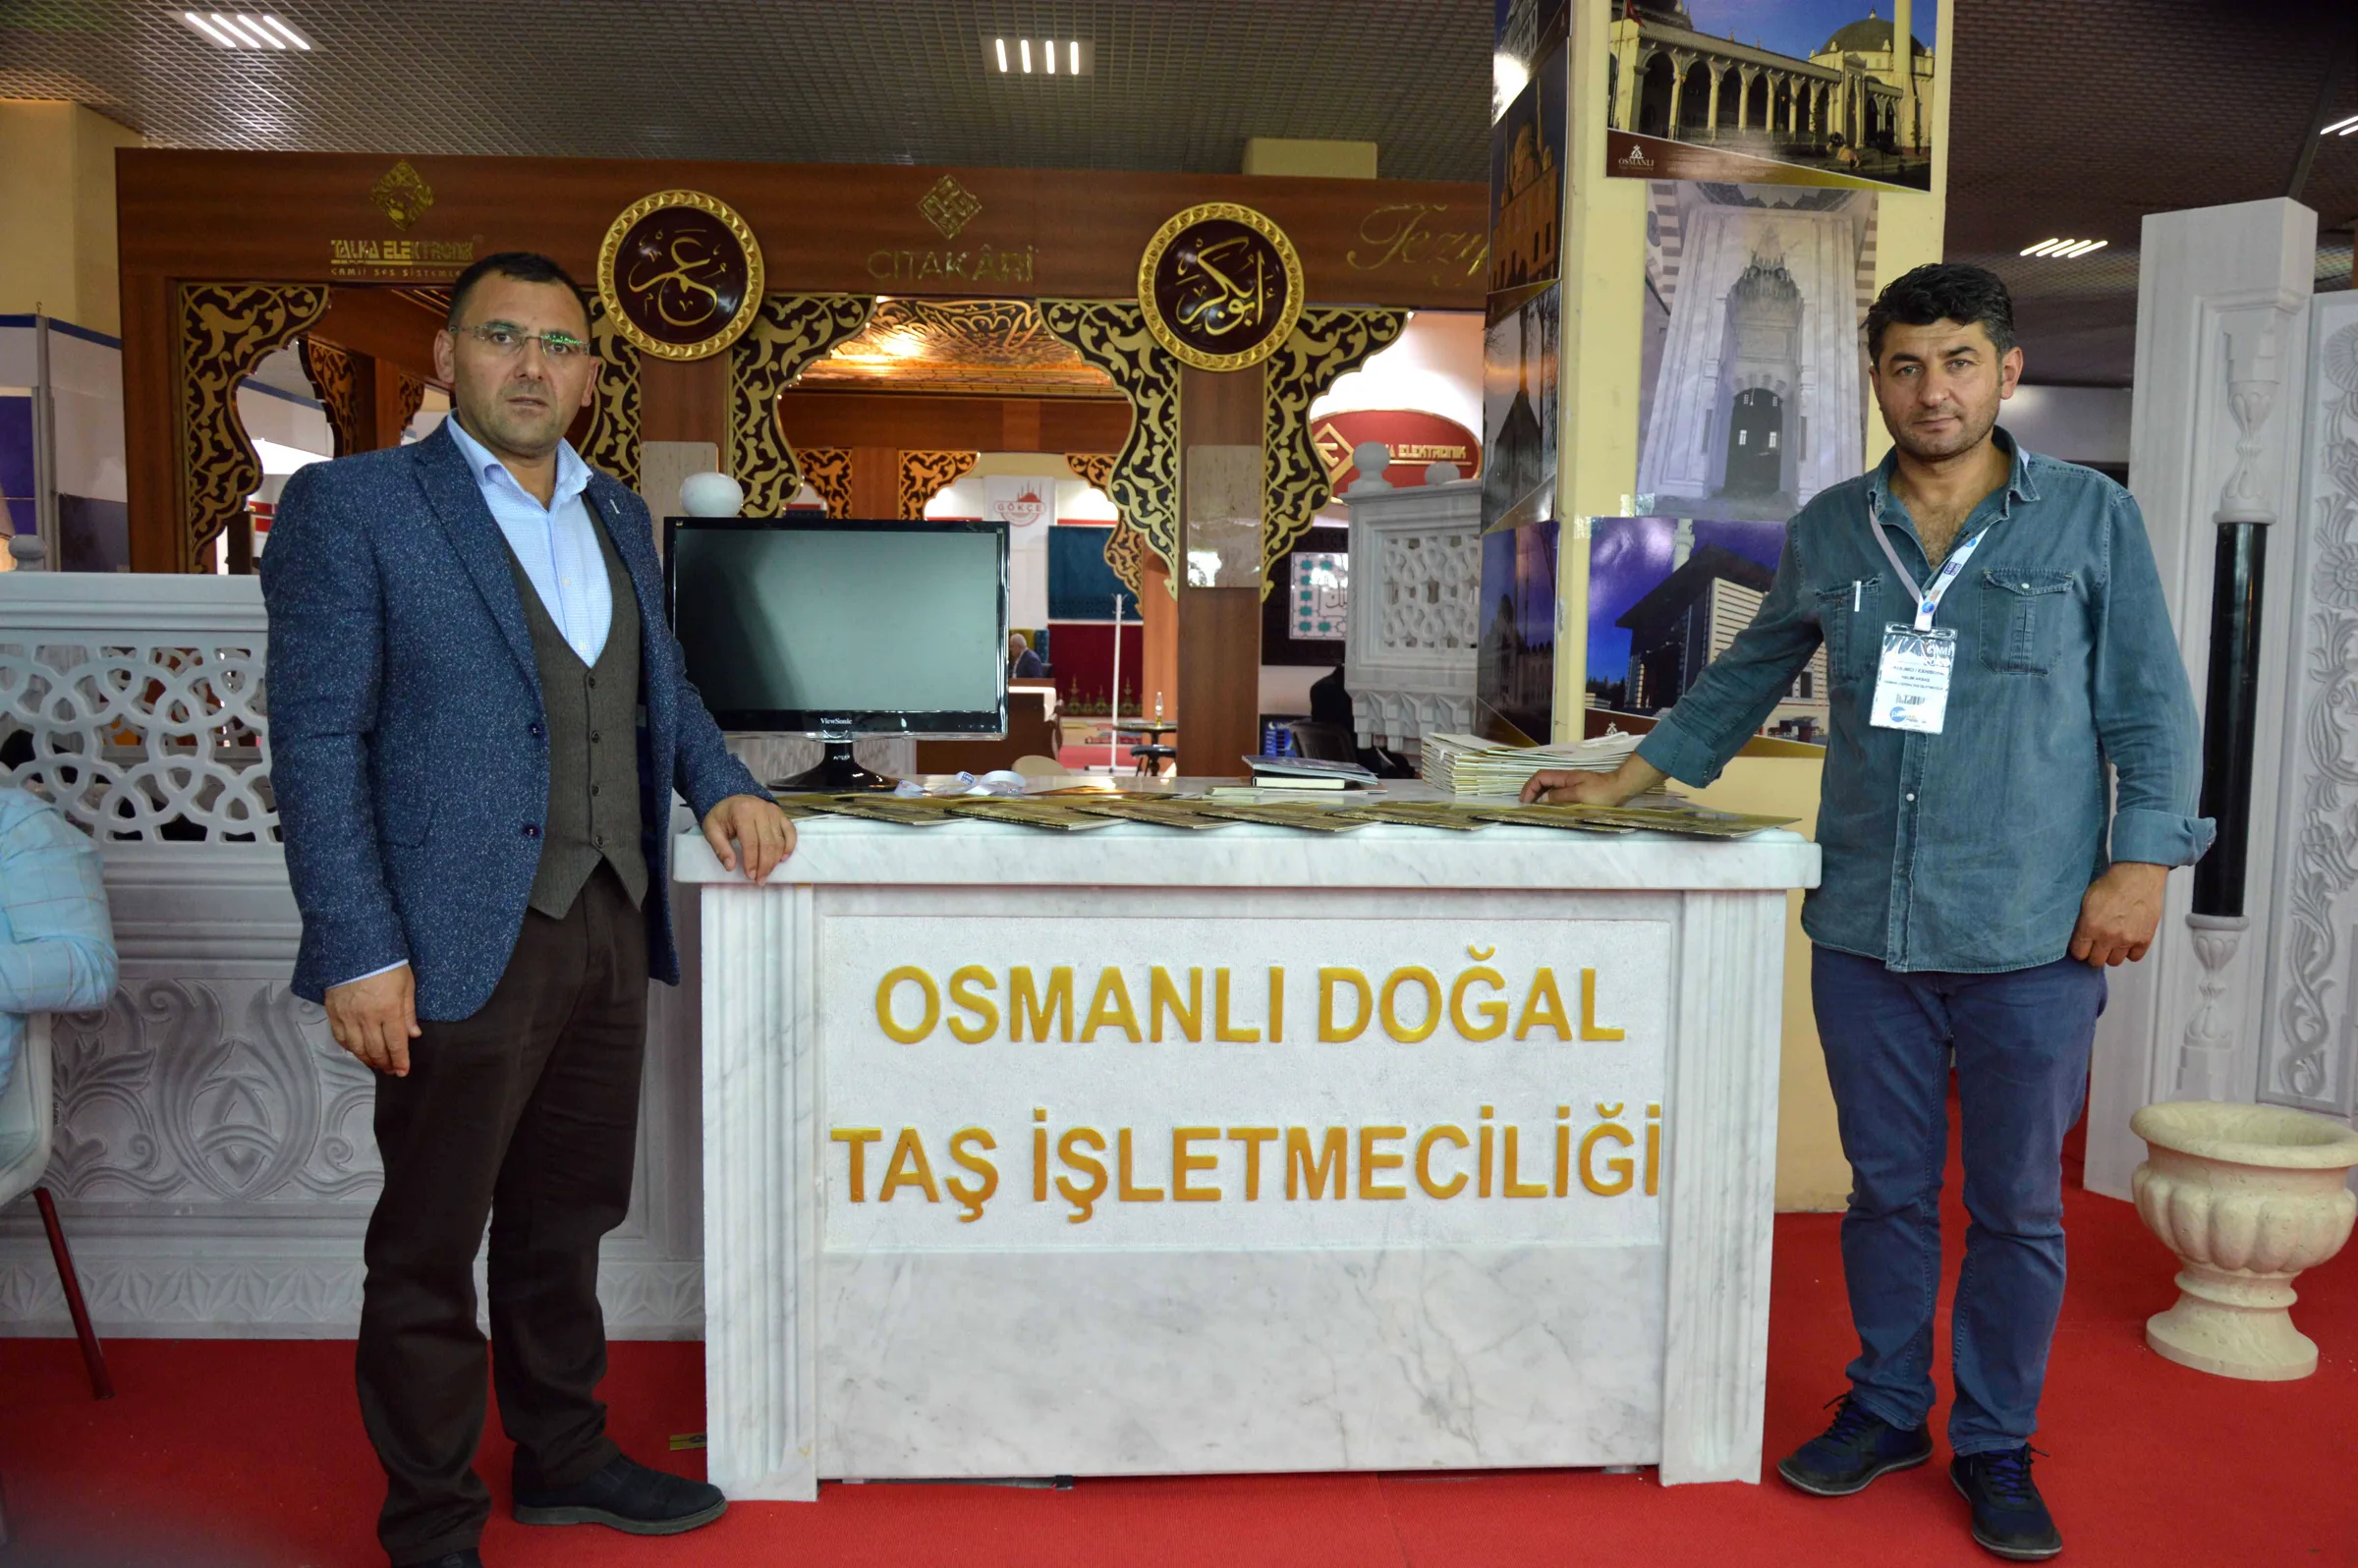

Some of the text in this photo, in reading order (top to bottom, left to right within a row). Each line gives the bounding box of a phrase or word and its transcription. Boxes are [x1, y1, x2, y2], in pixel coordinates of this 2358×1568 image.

[876, 945, 1626, 1044] OSMANLI DOĞAL
[831, 1102, 1661, 1223] TAŞ İŞLETMECİLİĞİ
